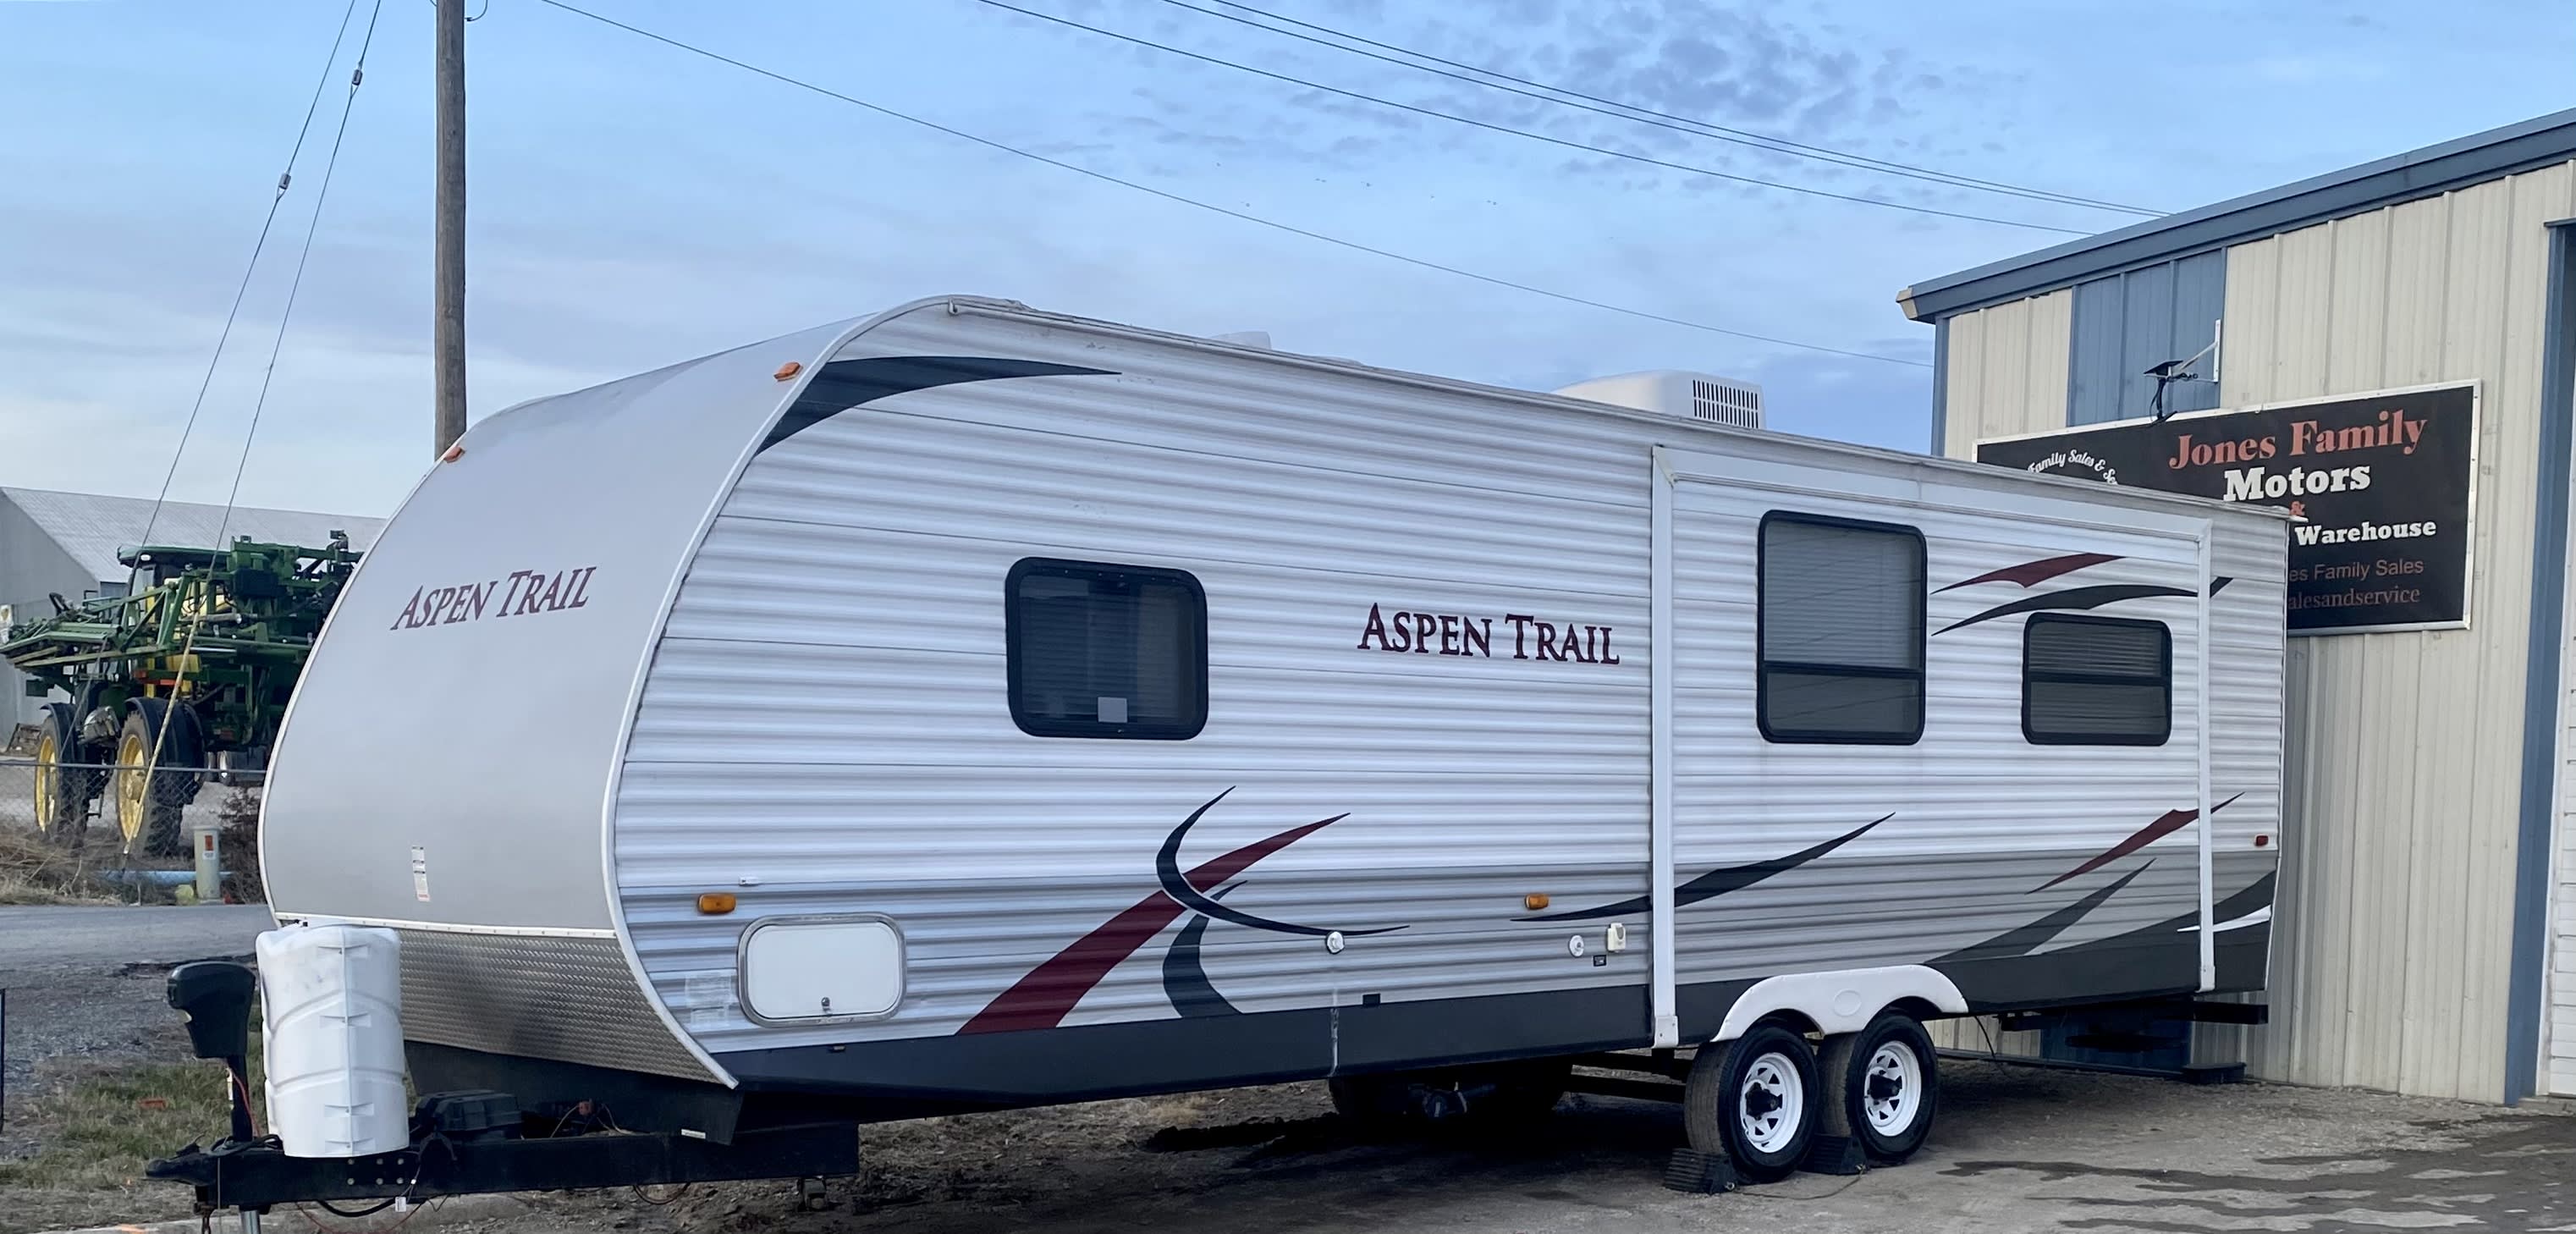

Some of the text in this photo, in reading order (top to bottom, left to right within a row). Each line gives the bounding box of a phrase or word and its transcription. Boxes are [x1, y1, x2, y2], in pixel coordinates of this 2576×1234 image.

[2169, 409, 2428, 469] Jones Family
[2028, 452, 2066, 474] Family
[2067, 449, 2094, 467] Sales
[2094, 459, 2106, 471] &
[2223, 466, 2371, 502] Motors
[2290, 500, 2306, 516] &
[2294, 521, 2437, 546] Warehouse
[2289, 558, 2425, 581] es Family Sales
[390, 566, 597, 631] ASPEN TRAIL
[2287, 586, 2420, 609] alesandservice
[1357, 602, 1620, 664] ASPEN TRAIL
